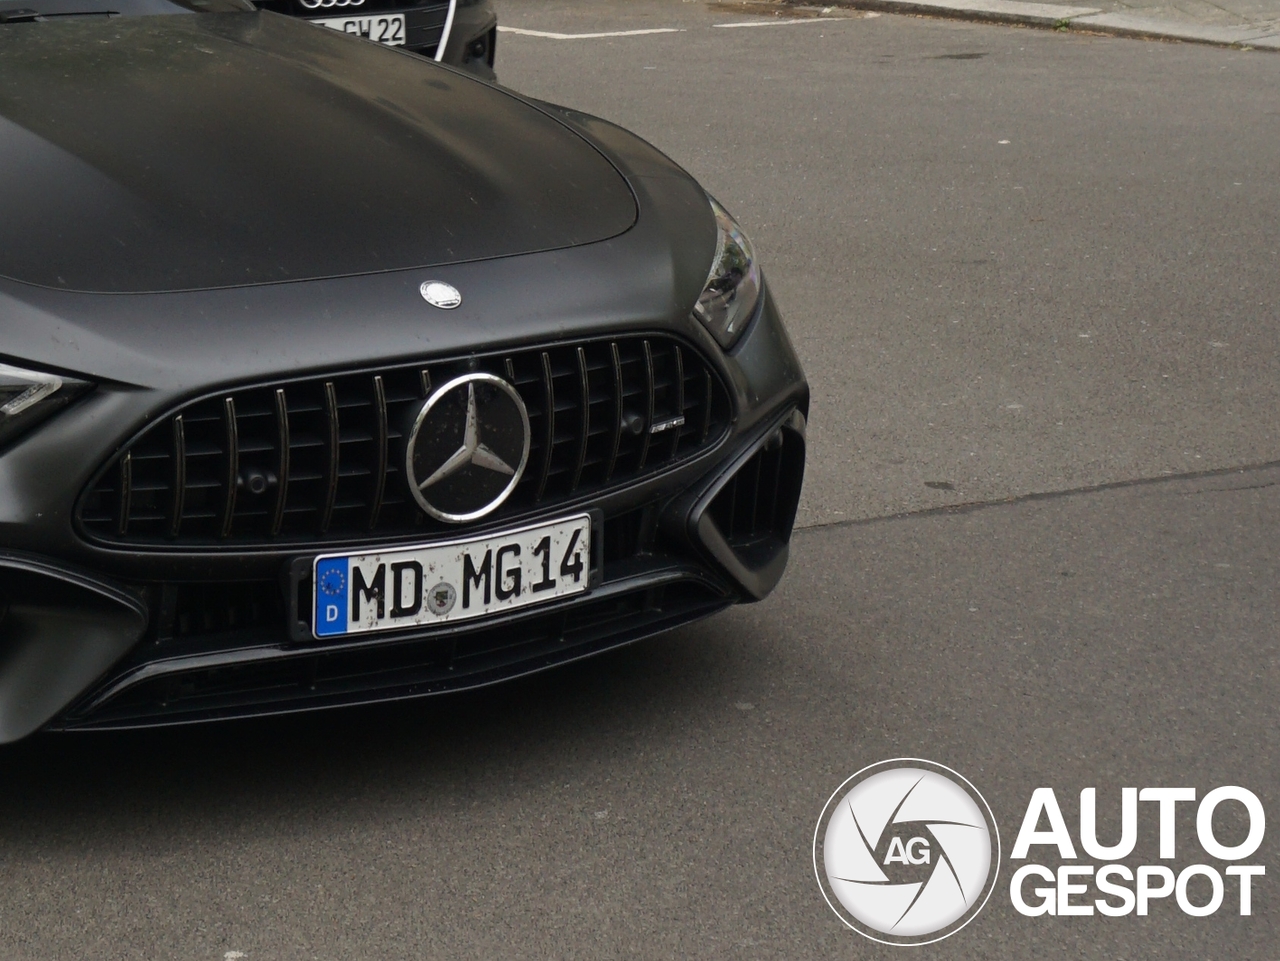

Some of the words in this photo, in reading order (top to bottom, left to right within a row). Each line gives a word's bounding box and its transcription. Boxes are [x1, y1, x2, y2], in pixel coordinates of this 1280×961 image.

[377, 17, 403, 43] 22
[326, 605, 339, 622] D
[352, 560, 424, 622] MD
